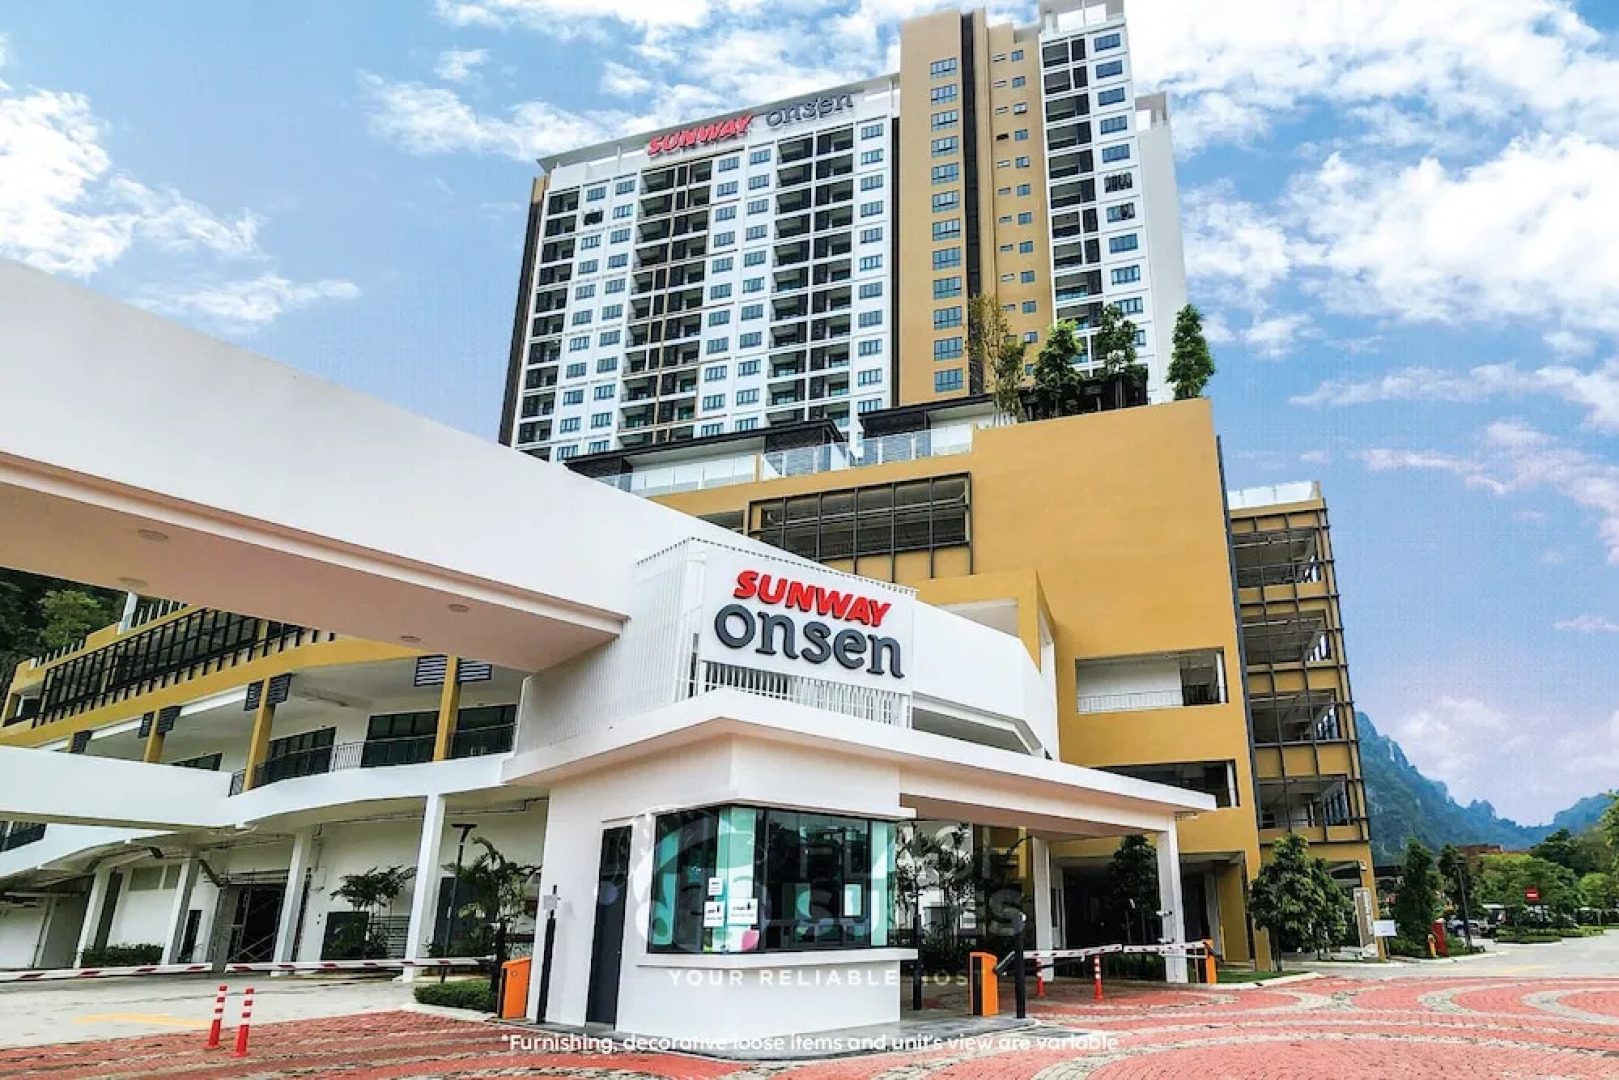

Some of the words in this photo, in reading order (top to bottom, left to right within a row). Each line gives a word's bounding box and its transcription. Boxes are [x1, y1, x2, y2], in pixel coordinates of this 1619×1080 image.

[648, 114, 753, 156] SUNWAY
[765, 93, 854, 127] onsen
[733, 569, 891, 627] SUNWAY
[714, 604, 905, 679] onsen
